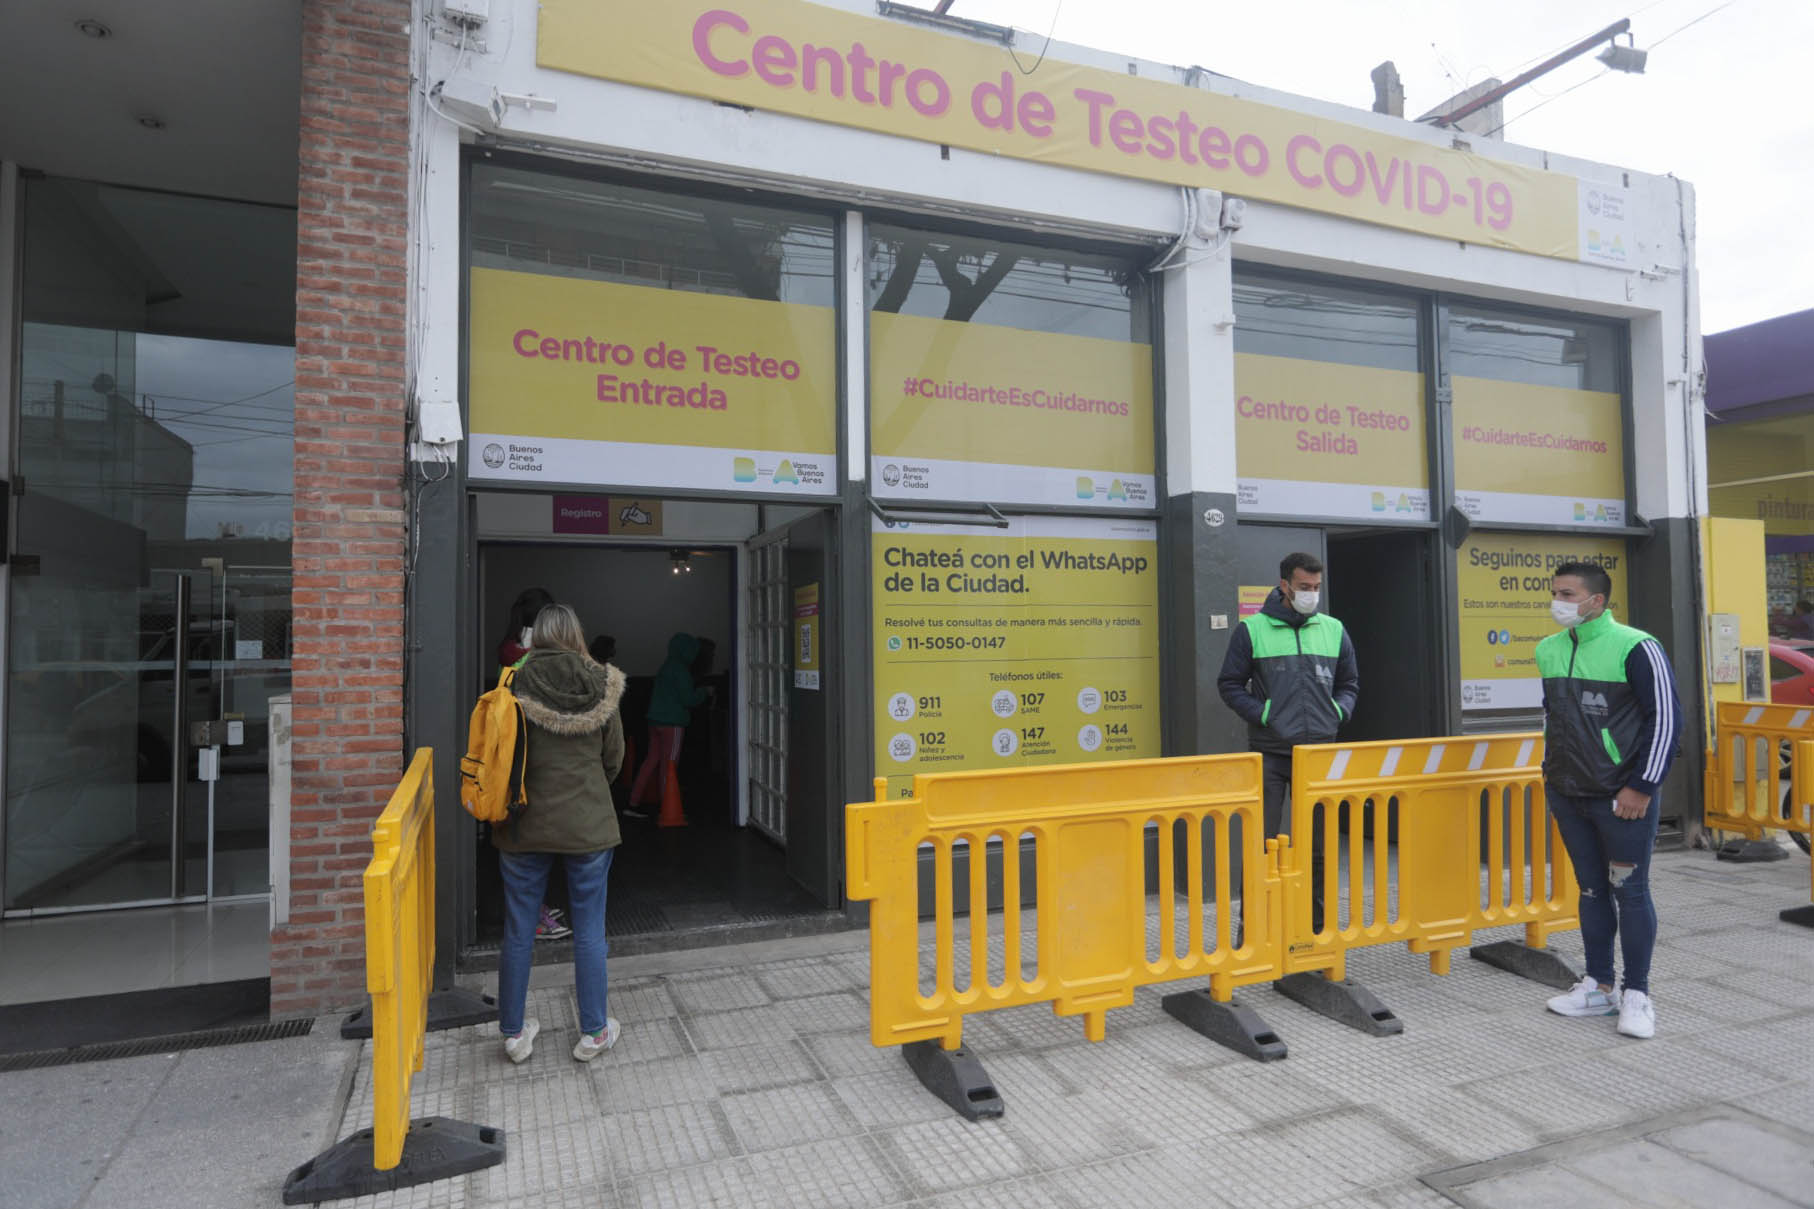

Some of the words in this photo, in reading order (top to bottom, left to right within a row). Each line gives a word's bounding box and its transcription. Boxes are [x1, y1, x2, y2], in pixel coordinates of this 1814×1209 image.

[692, 9, 952, 119] Centro
[971, 71, 1057, 138] de
[1073, 87, 1270, 178] Testeo
[1285, 134, 1515, 232] COVID-19
[513, 329, 634, 367] Centro
[643, 341, 686, 370] de
[696, 346, 801, 381] Testeo
[596, 374, 729, 411] Entrada
[903, 377, 1129, 416] #CuidarteEsCuidarnos
[1237, 395, 1310, 423] Centro
[1315, 403, 1341, 426] de
[1346, 405, 1411, 431] Testeo
[1296, 429, 1359, 456] Salida
[1461, 426, 1608, 454] #CuidarteEsCuidarnos
[508, 444, 544, 454] Buenos
[508, 453, 535, 462] Aires
[508, 462, 543, 472] Ciudad
[792, 461, 818, 470] Vamos
[903, 464, 930, 474] Buenos
[797, 469, 825, 477] Buenos
[903, 473, 923, 481] Aires
[903, 480, 929, 489] Ciudad
[560, 507, 603, 520] Registro
[884, 547, 964, 569] Chateá
[970, 553, 1011, 570] con
[1016, 550, 1034, 569] el
[1040, 551, 1148, 575] WhatsApp
[1470, 547, 1542, 571] Seguinos
[884, 571, 914, 593] de
[921, 573, 940, 593] la
[946, 573, 1030, 594] Ciudad.
[1500, 576, 1519, 591] en
[1464, 599, 1484, 609] Estos
[1486, 600, 1499, 609] son
[1500, 600, 1532, 609] nuestros
[885, 617, 925, 627] Resolvé
[928, 618, 944, 627] tus
[946, 617, 993, 627] consultas
[995, 617, 1009, 627] de
[1010, 619, 1046, 627] manera
[1048, 617, 1067, 626] más
[1069, 616, 1103, 626] sencilla
[1104, 618, 1111, 628] y
[1112, 616, 1144, 629] rápida.
[906, 636, 1007, 650] 11-5050-0147
[989, 672, 1034, 682] Teléfonos
[1036, 670, 1064, 681] útiles:
[918, 696, 942, 709] 911
[1020, 693, 1046, 706] 107
[1103, 690, 1128, 703] 103
[1021, 727, 1046, 741] 147
[1105, 723, 1129, 737] 144
[919, 732, 946, 745] 102
